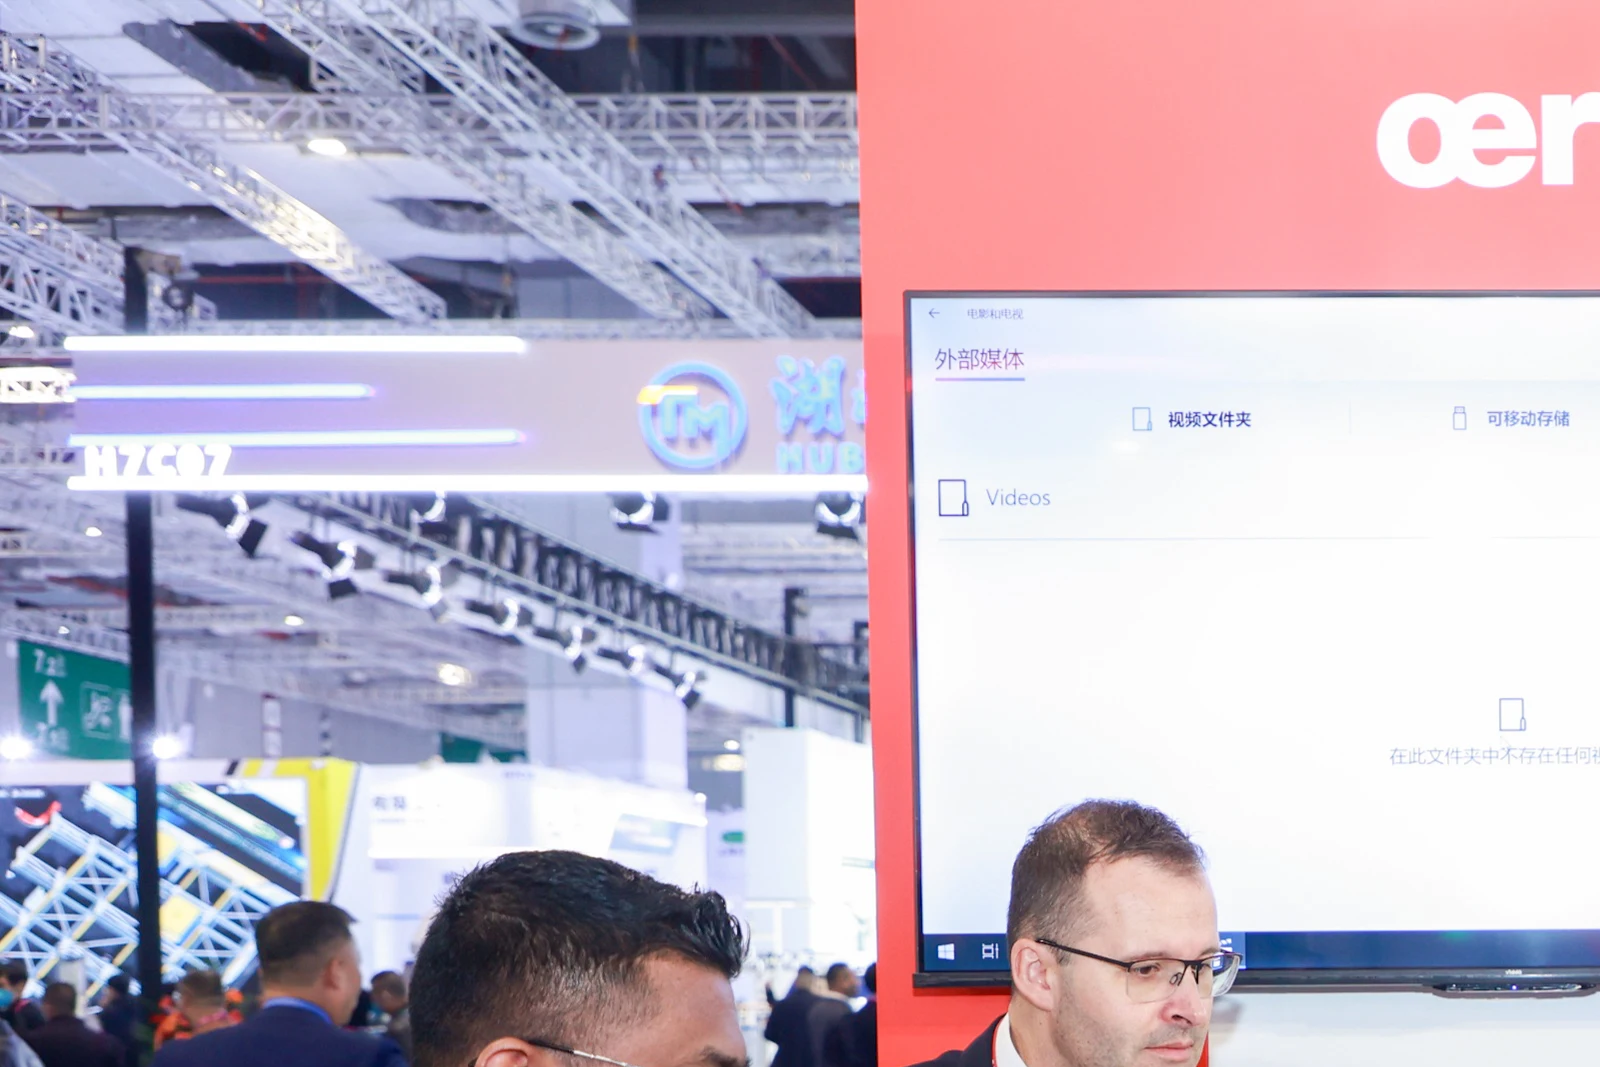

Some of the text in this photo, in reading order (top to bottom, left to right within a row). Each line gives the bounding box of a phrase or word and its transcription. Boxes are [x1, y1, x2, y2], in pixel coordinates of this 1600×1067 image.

[967, 308, 1024, 320] 电影和电视
[934, 347, 1025, 372] 外部媒体
[1167, 410, 1253, 429] 视频文件夹
[1486, 409, 1571, 428] 可移动存储
[986, 488, 1051, 507] Videos
